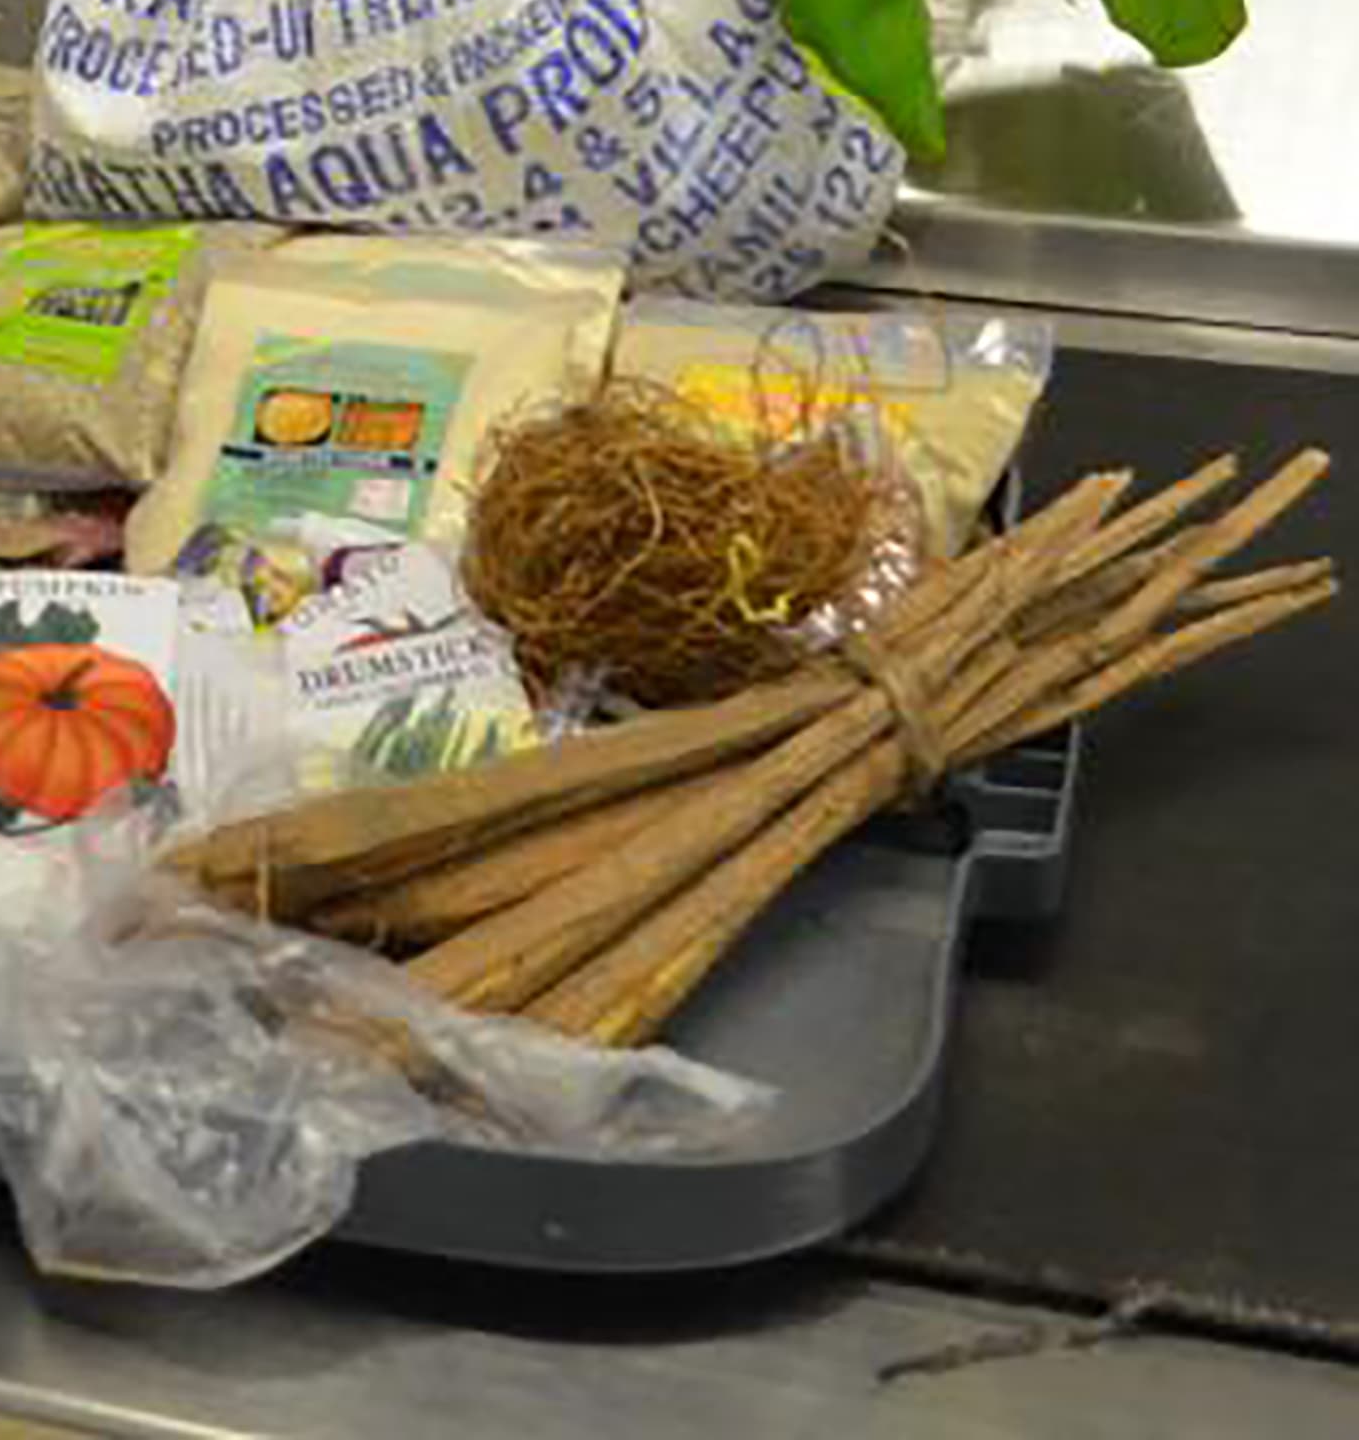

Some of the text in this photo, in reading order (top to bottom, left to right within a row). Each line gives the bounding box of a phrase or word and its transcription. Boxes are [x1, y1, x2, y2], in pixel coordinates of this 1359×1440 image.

[151, 64, 416, 157] PROCESSED
[264, 112, 474, 218] AQUA
[297, 633, 492, 697] DRUMSTICK
